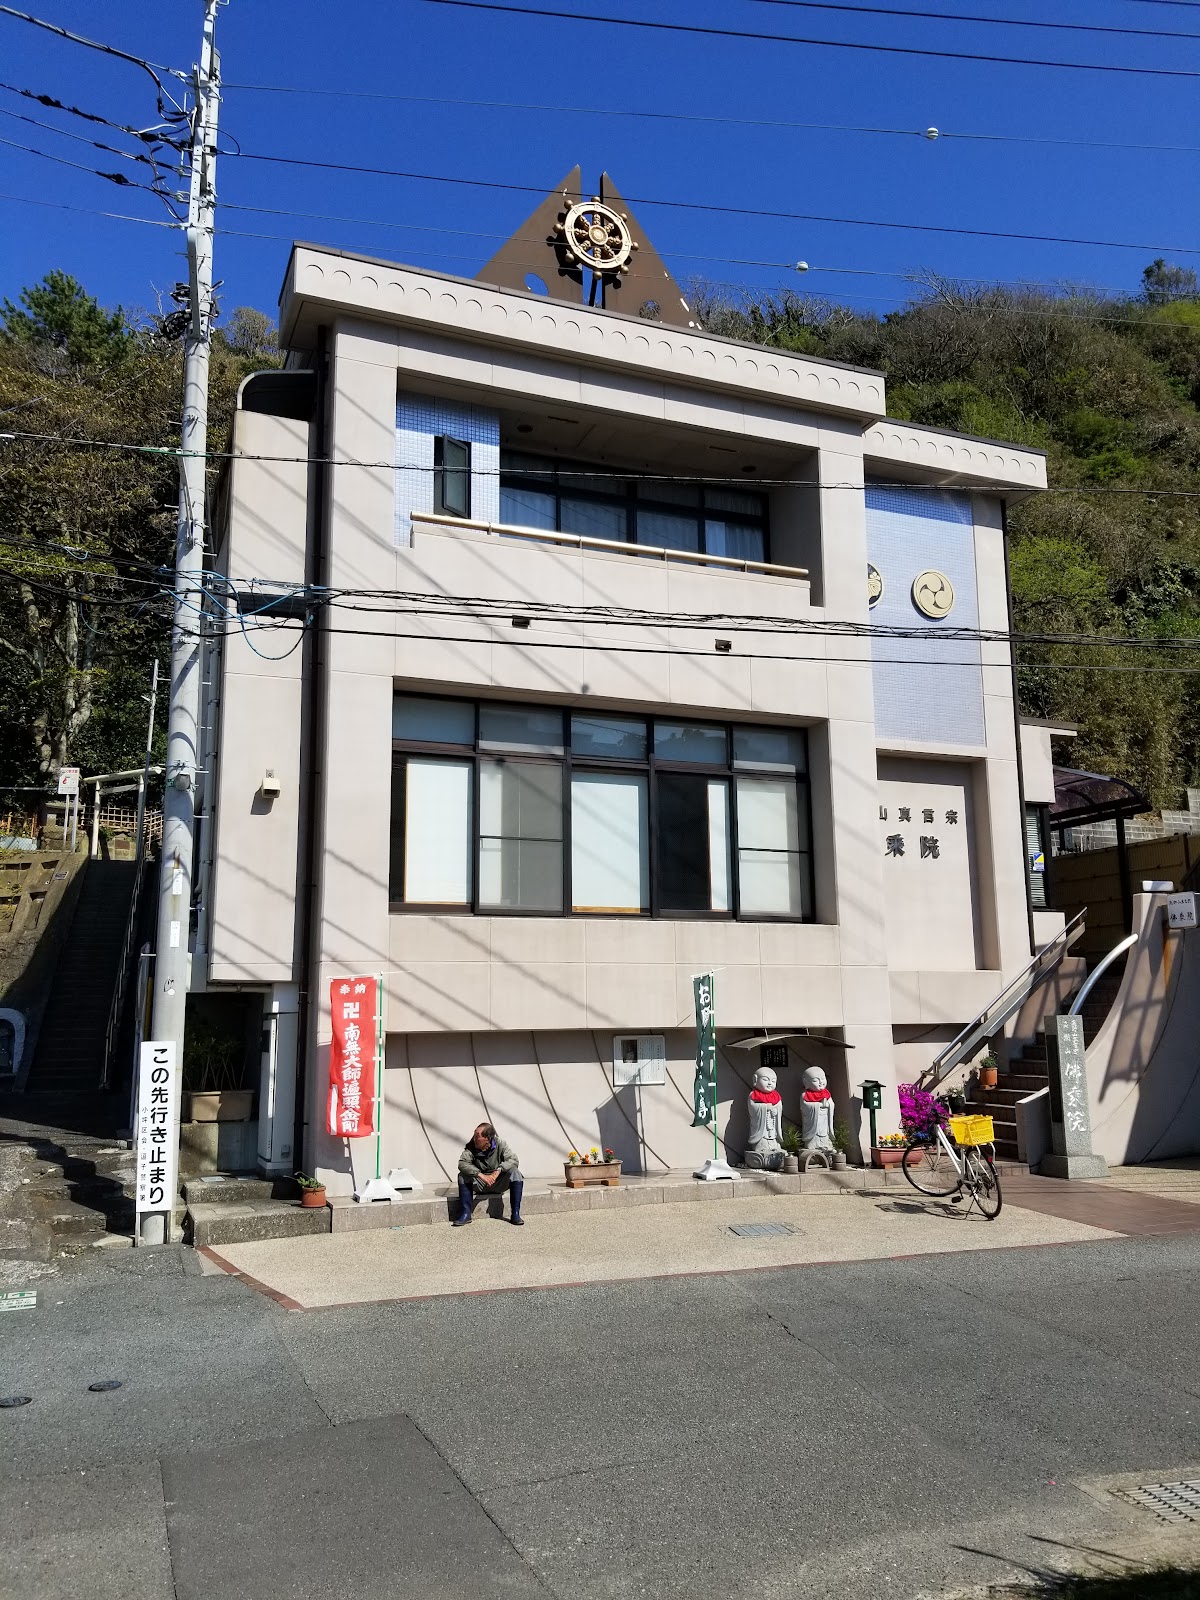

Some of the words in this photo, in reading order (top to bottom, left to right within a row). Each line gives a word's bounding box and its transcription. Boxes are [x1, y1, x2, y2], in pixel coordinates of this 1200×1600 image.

[339, 983, 366, 995] 奉納
[149, 1048, 169, 1204] この先行き止まり
